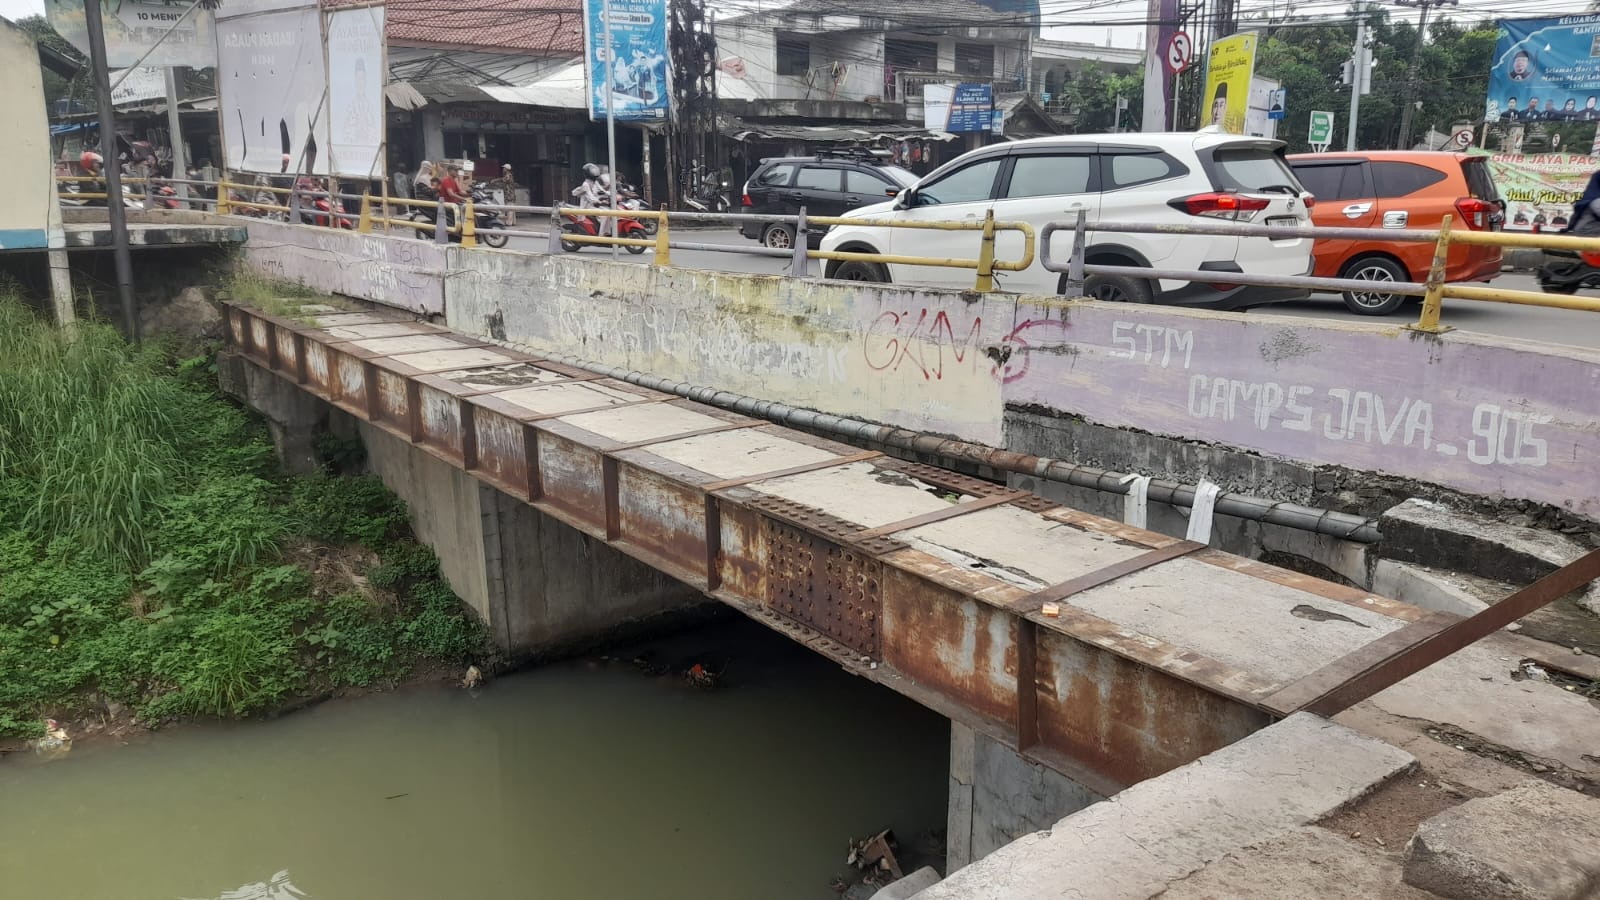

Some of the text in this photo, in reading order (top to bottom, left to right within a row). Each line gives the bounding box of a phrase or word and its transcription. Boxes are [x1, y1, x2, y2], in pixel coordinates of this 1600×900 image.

[137, 12, 149, 21] 10
[1491, 153, 1525, 164] GRIB
[1529, 154, 1563, 165] JAYA
[1108, 320, 1194, 369] STM
[1187, 373, 1314, 431] CAMPS
